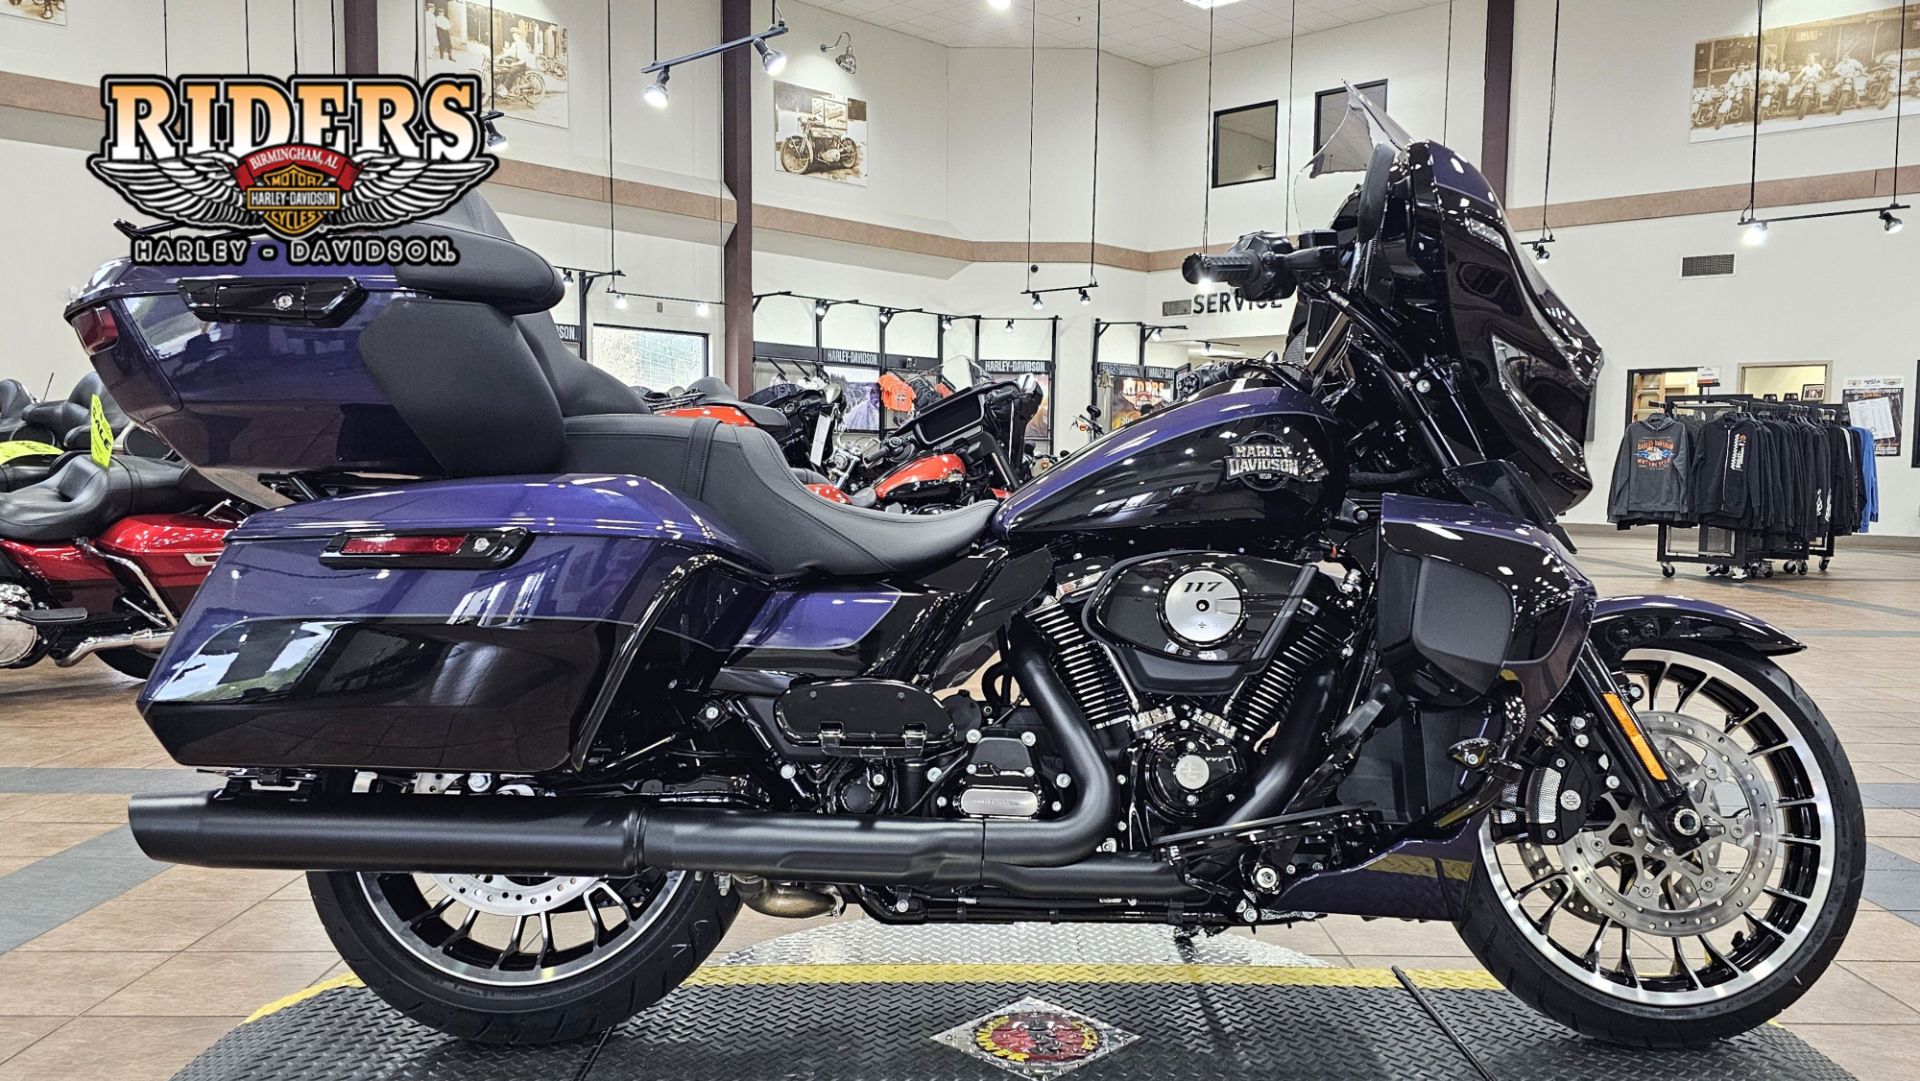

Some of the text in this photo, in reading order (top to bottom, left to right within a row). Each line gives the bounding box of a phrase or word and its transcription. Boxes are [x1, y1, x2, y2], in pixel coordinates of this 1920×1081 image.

[827, 349, 878, 365] HARLEY-DAVIDSON
[984, 360, 1046, 372] HARLEY-DAVIDSON
[1229, 458, 1299, 477] DAVIDSON
[1183, 581, 1223, 593] 117
